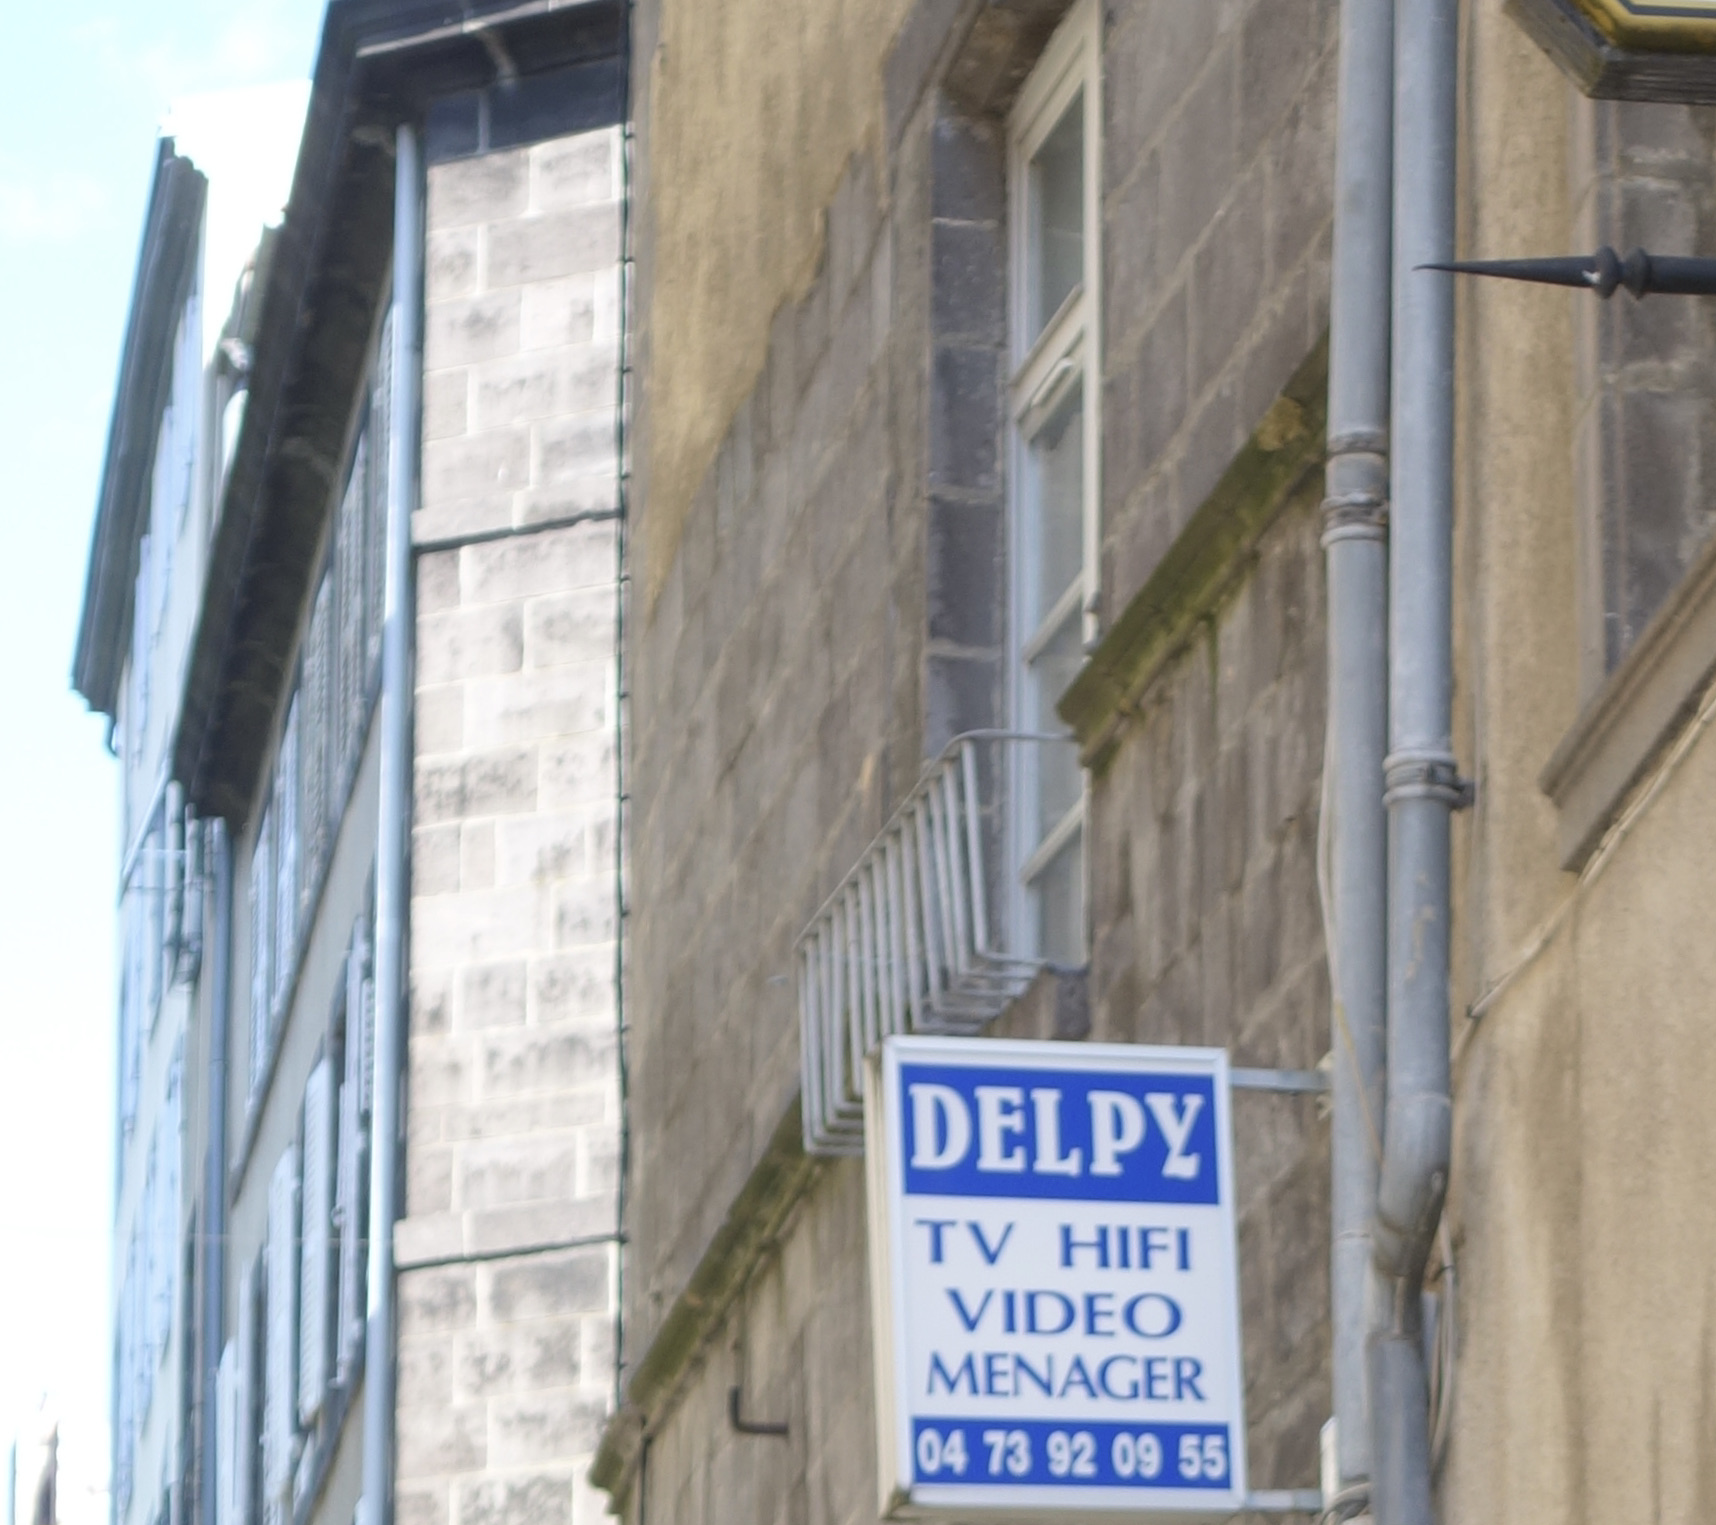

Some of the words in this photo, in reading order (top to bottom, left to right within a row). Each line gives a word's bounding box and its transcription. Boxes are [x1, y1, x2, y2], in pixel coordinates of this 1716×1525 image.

[907, 1082, 1206, 1180] DELPY
[914, 1218, 1016, 1268] TV
[1058, 1222, 1194, 1272] HIFI
[944, 1287, 1184, 1340] VIDEO
[925, 1349, 1208, 1402] MENAGER
[915, 1427, 970, 1476] 04
[982, 1429, 1033, 1478] 73
[1046, 1430, 1098, 1479] 92
[1111, 1432, 1164, 1480] 09
[1178, 1433, 1227, 1482] 55
